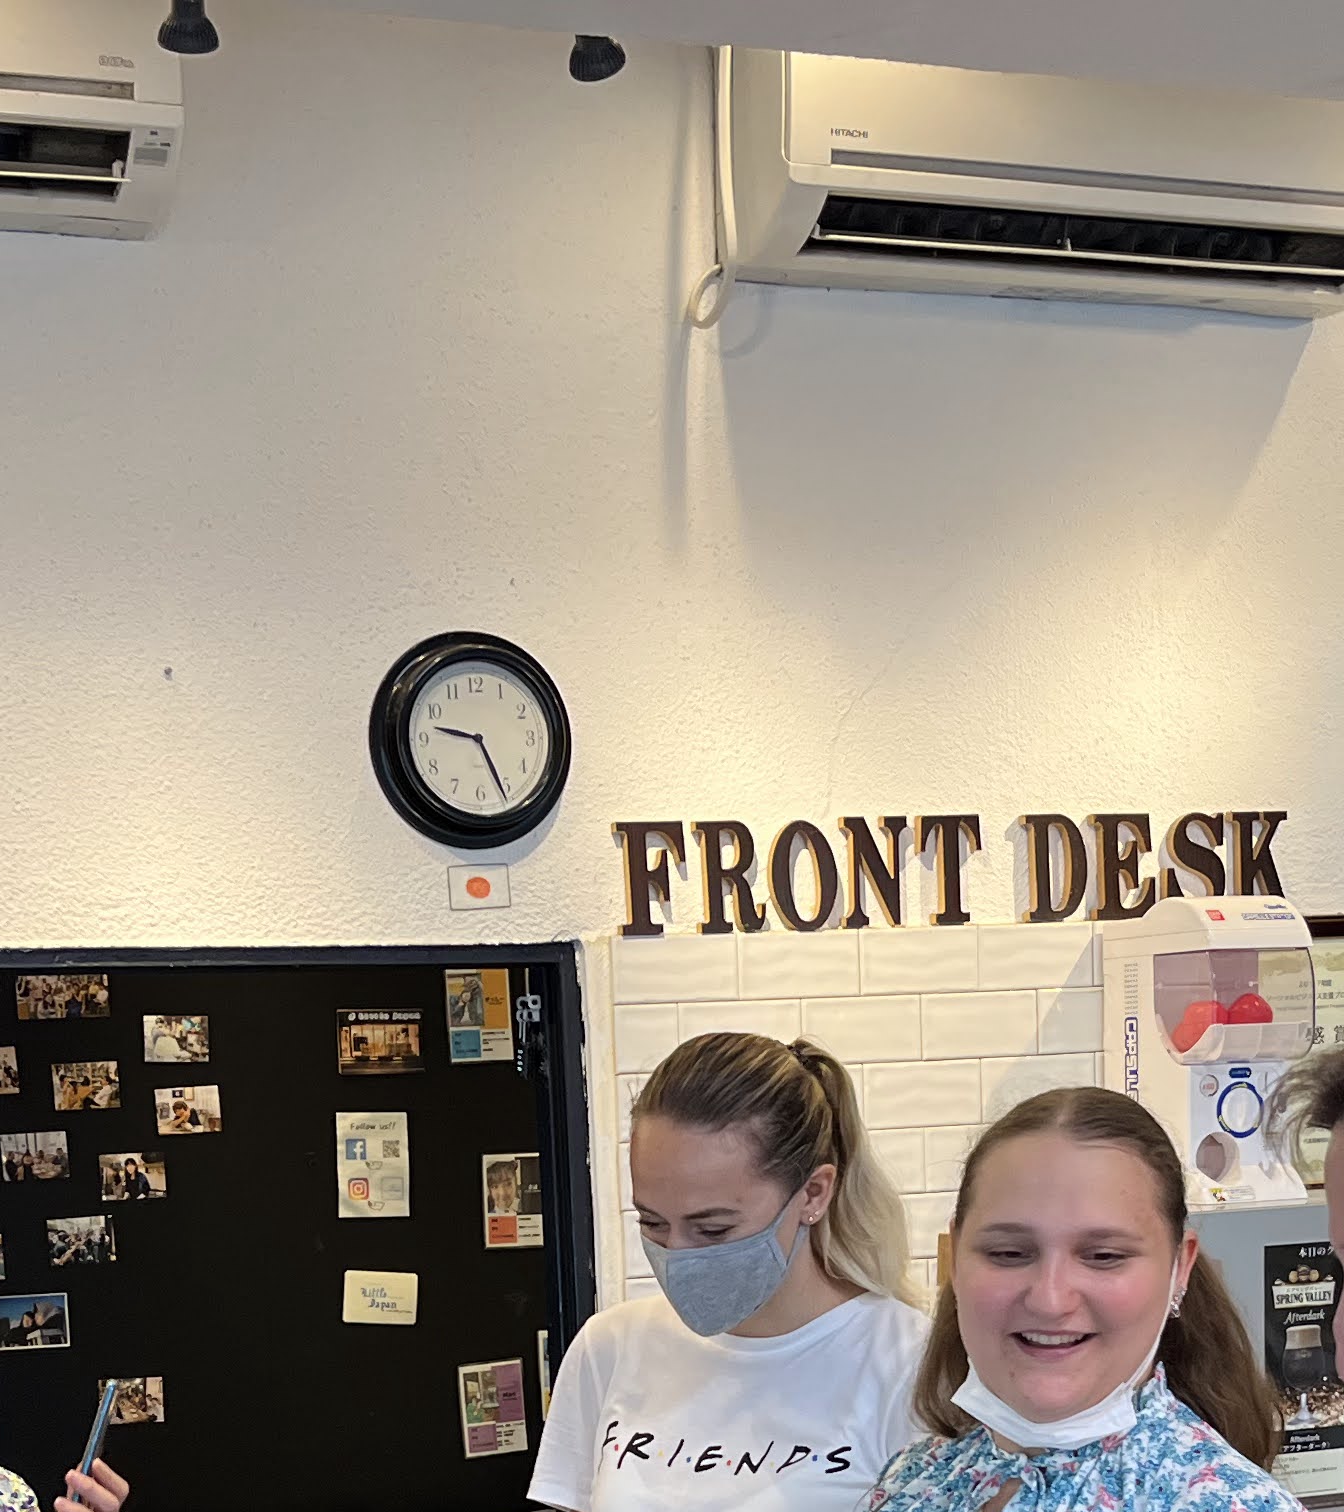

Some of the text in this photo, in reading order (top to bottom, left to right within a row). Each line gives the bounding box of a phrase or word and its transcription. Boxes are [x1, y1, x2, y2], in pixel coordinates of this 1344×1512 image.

[830, 127, 869, 139] HITACHI
[446, 682, 460, 701] 11
[467, 676, 484, 694] 12
[497, 682, 504, 700] 1
[427, 703, 442, 721] 10
[515, 702, 526, 721] 2
[418, 731, 429, 749] 9
[524, 729, 536, 748] 3
[428, 758, 439, 777] 8
[449, 777, 460, 796] 7
[475, 784, 487, 802] 6
[610, 810, 1288, 936] FRONT DESK
[350, 1122, 376, 1131] Follow
[368, 1298, 397, 1312] Japan
[1275, 1290, 1332, 1306] SPRING VALLEY
[1283, 1308, 1326, 1326] Afterdark
